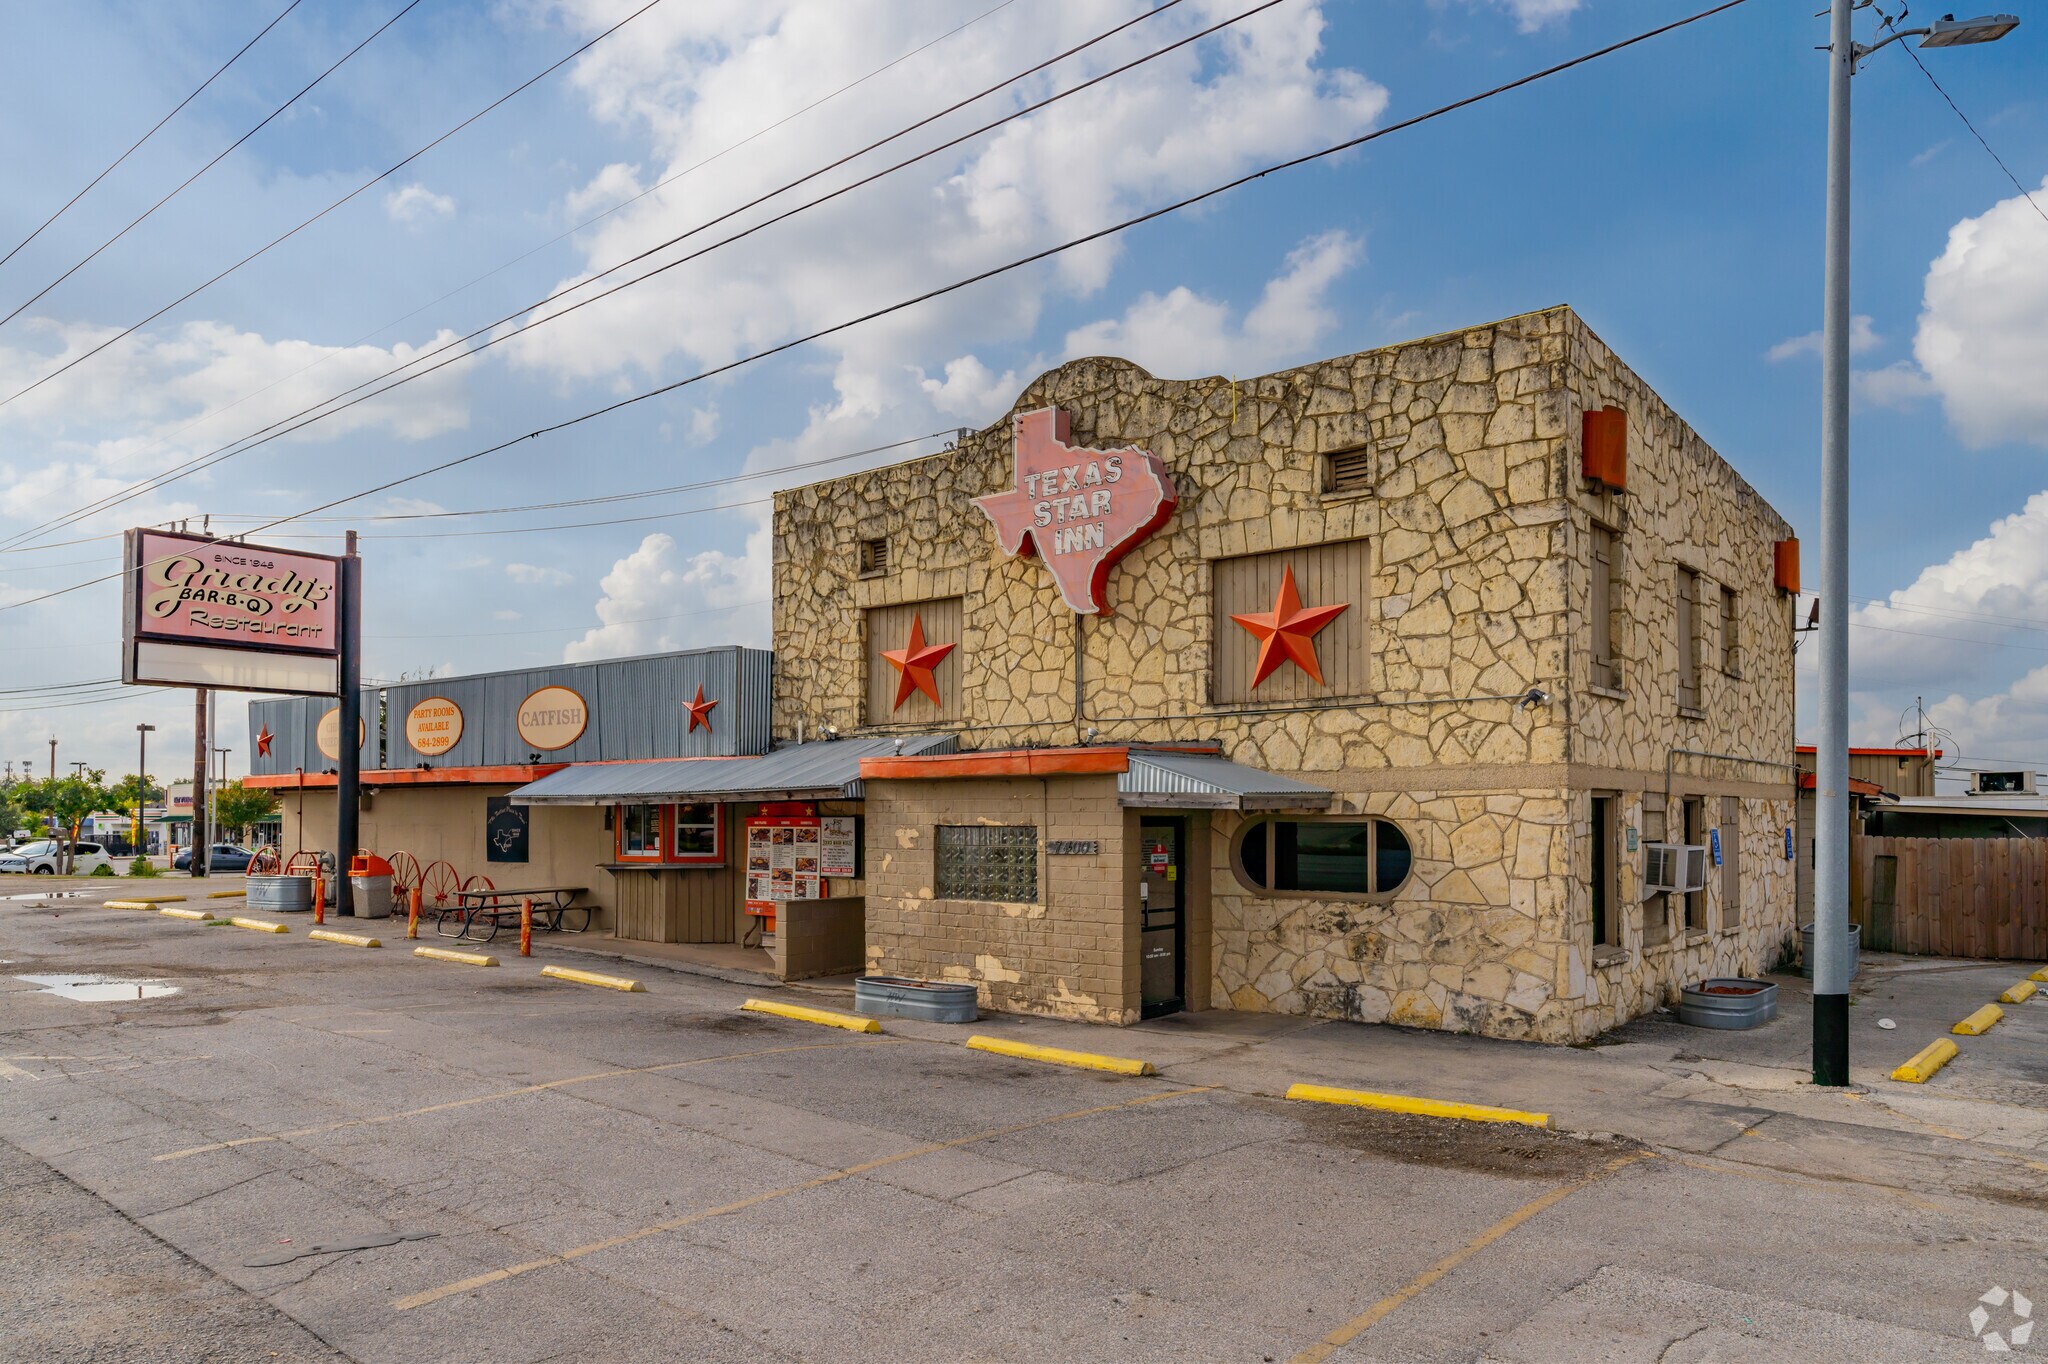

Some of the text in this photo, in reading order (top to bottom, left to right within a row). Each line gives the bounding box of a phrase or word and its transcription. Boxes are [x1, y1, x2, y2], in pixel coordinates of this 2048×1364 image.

[1023, 456, 1123, 500] TEXAS
[1033, 489, 1112, 527] STAR
[1054, 521, 1104, 556] INN
[214, 554, 274, 570] SINCE 1948
[147, 555, 333, 618] Grady's
[189, 610, 323, 639] Restaurant
[413, 706, 455, 719] PARTY ROOMS
[521, 708, 582, 728] CATFISH
[417, 721, 450, 732] AVAILABLE
[417, 736, 450, 748] 684-2899
